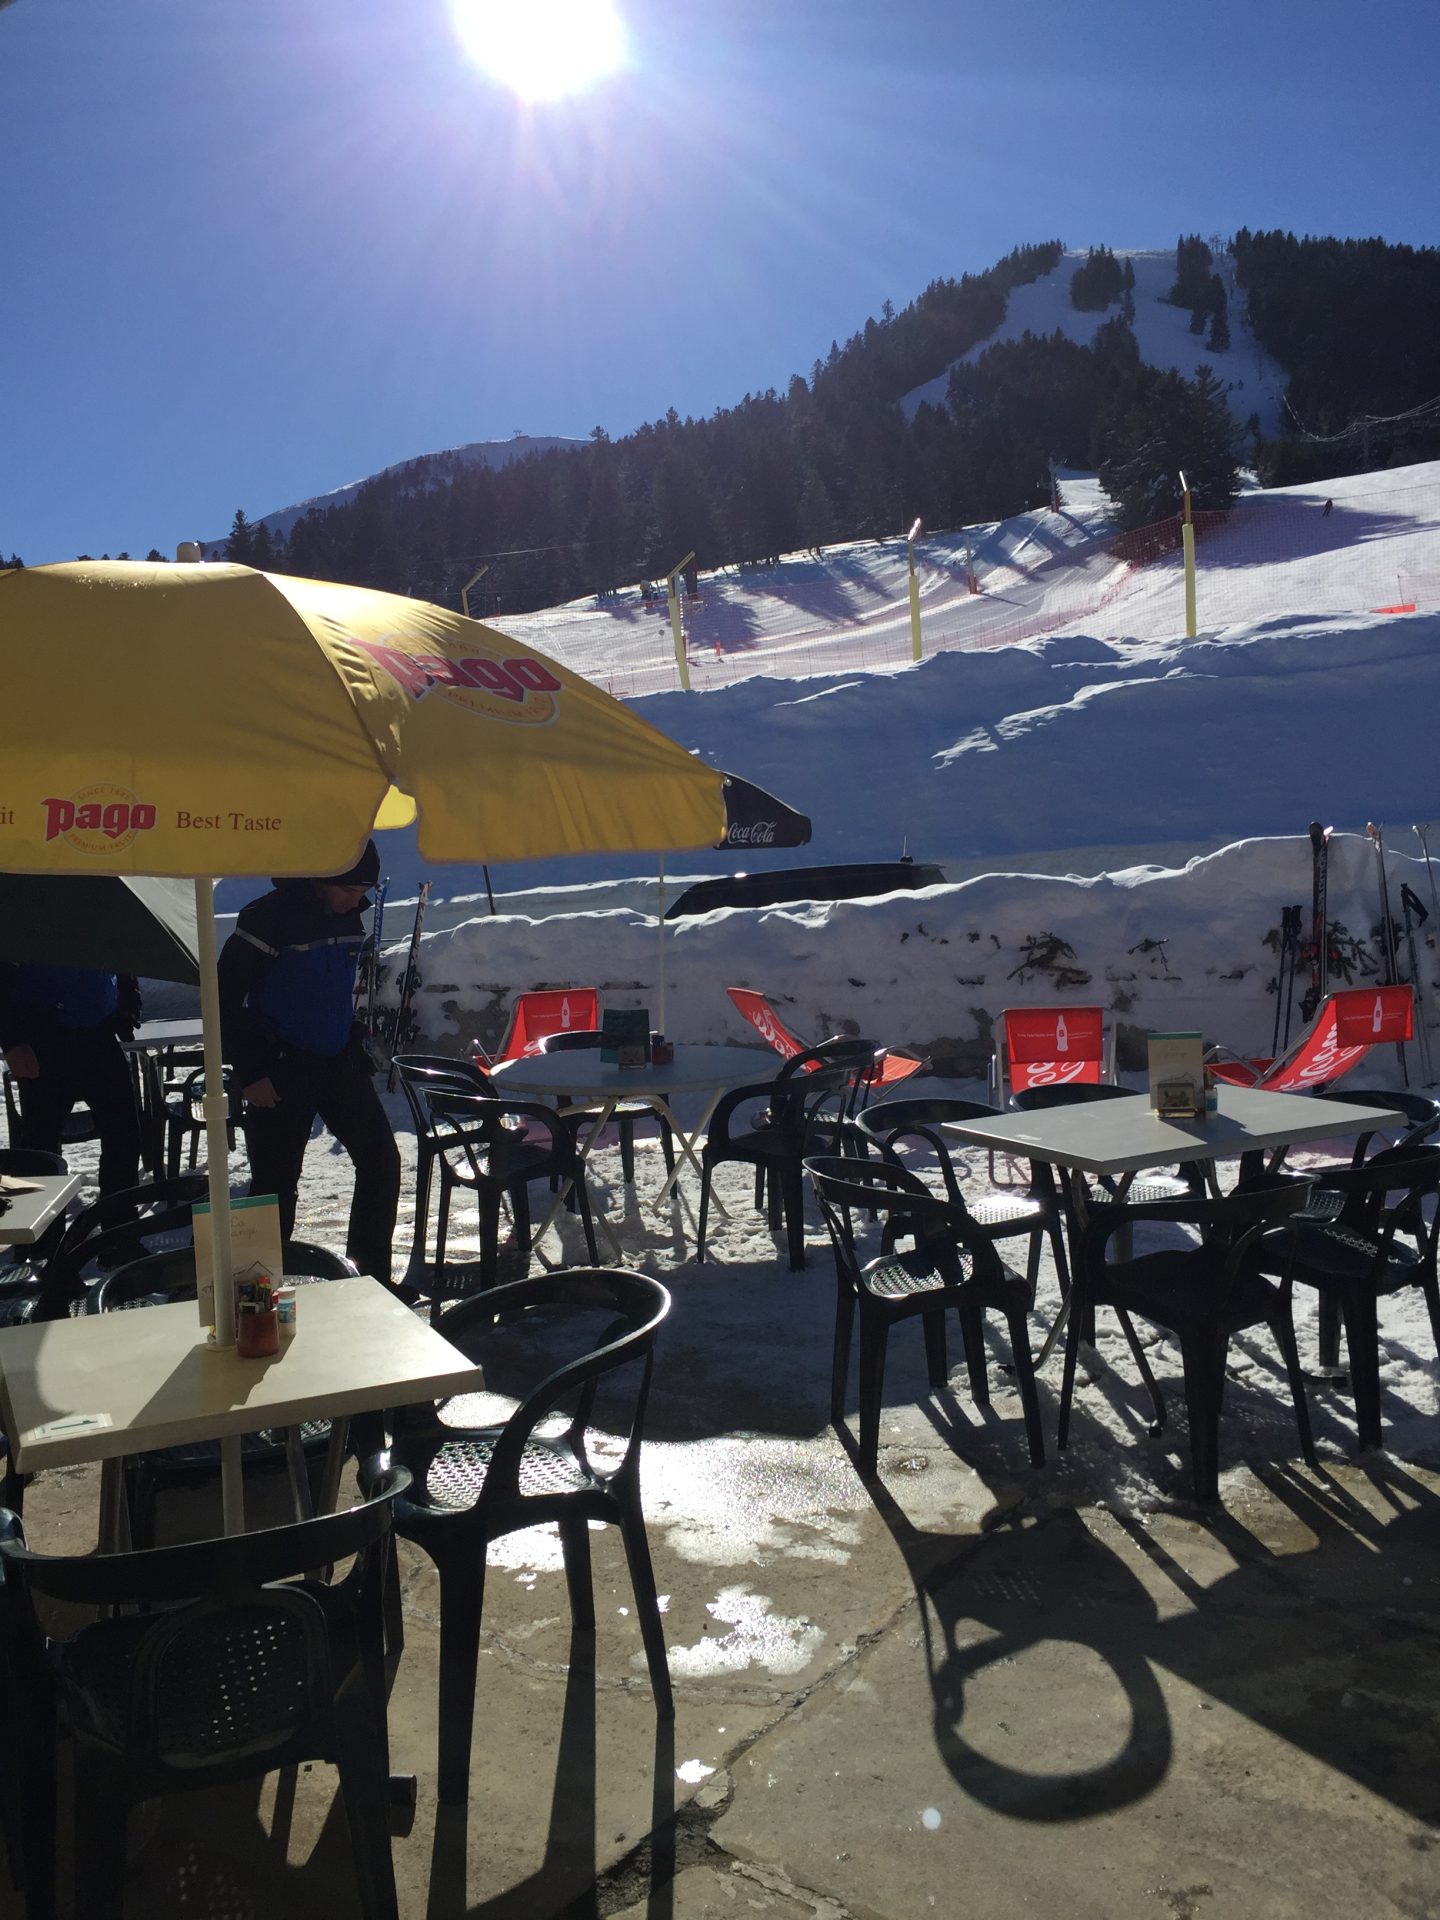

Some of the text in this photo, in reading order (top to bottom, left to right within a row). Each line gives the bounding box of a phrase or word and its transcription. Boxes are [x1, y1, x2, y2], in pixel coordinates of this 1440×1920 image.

[349, 637, 562, 703] pago
[41, 798, 156, 841] pago
[175, 811, 282, 831] Best Taste
